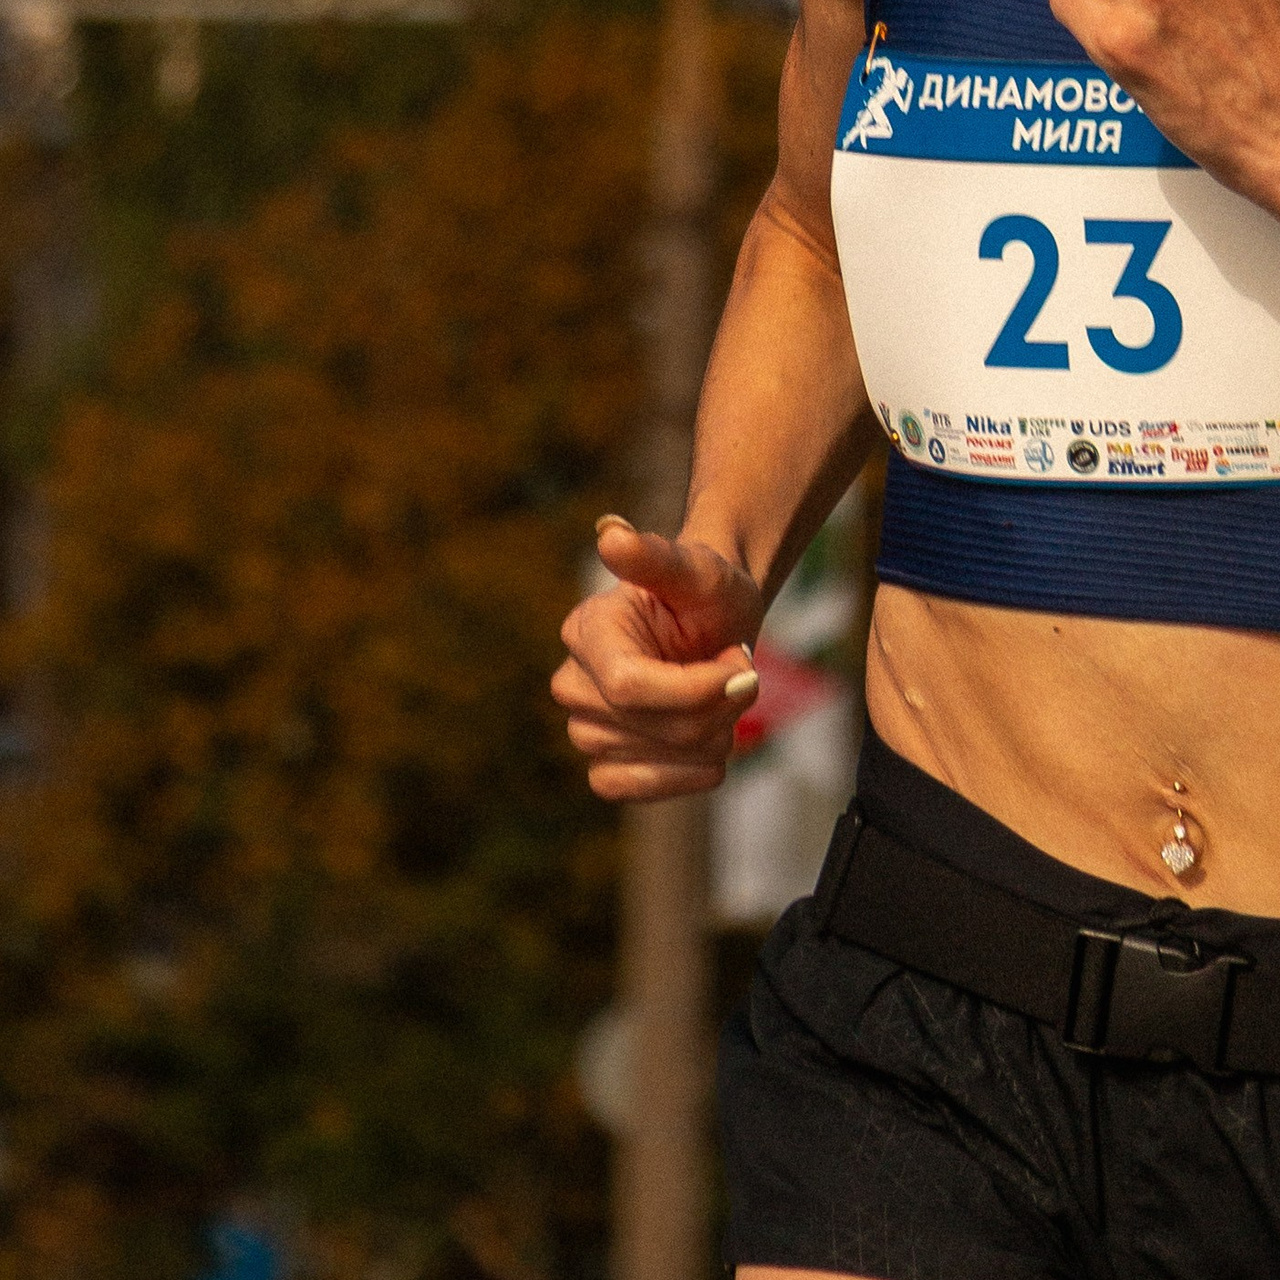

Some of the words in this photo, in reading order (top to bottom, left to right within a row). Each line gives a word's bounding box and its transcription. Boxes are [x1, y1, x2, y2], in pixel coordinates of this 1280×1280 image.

[919, 72, 1144, 114] ДИНАМОВС
[1012, 117, 1123, 154] МИЛЯ
[978, 213, 1184, 375] 23
[965, 414, 1012, 435] Nika
[1089, 419, 1132, 437] UDS
